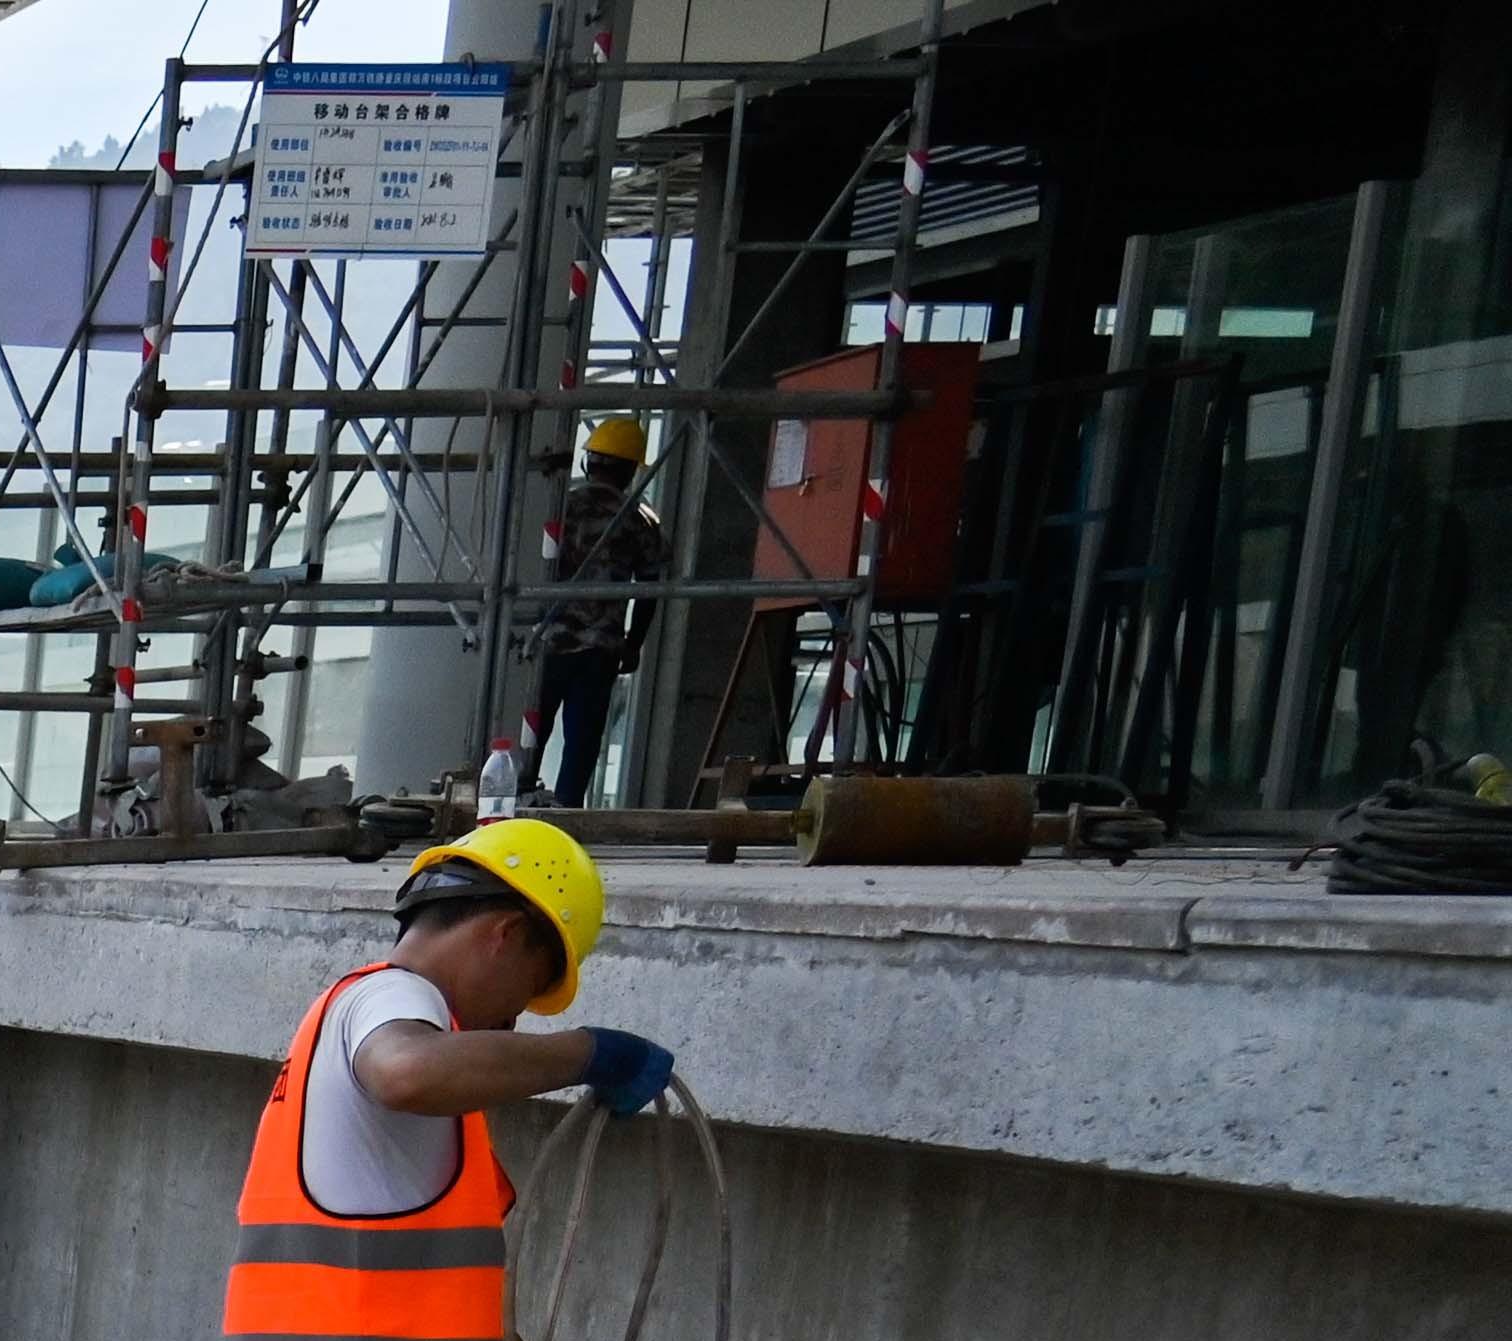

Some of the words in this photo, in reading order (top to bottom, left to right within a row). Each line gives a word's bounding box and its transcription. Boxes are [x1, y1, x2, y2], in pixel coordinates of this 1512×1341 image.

[313, 103, 451, 121] 移动台架合格牌
[373, 218, 413, 231] 验收日期
